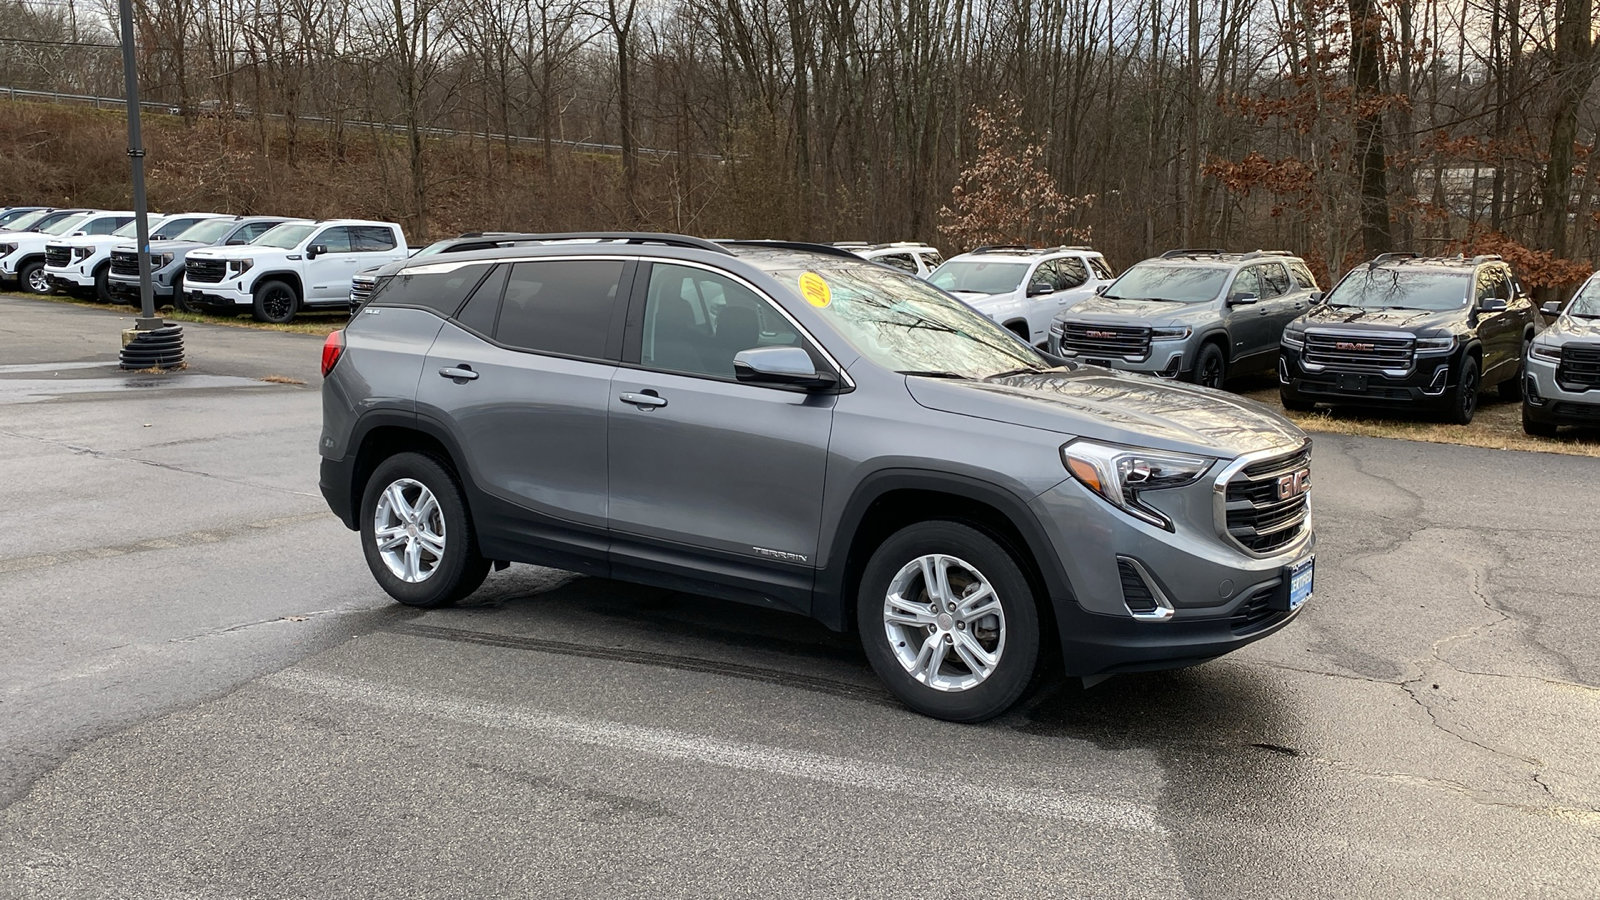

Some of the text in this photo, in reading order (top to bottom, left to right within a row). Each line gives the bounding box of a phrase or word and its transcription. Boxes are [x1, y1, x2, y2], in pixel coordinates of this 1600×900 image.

[804, 275, 826, 304] 2021
[1085, 330, 1117, 339] GMC
[1336, 342, 1375, 352] GMC
[1278, 469, 1311, 500] GMC
[752, 546, 808, 562] TERRAIN
